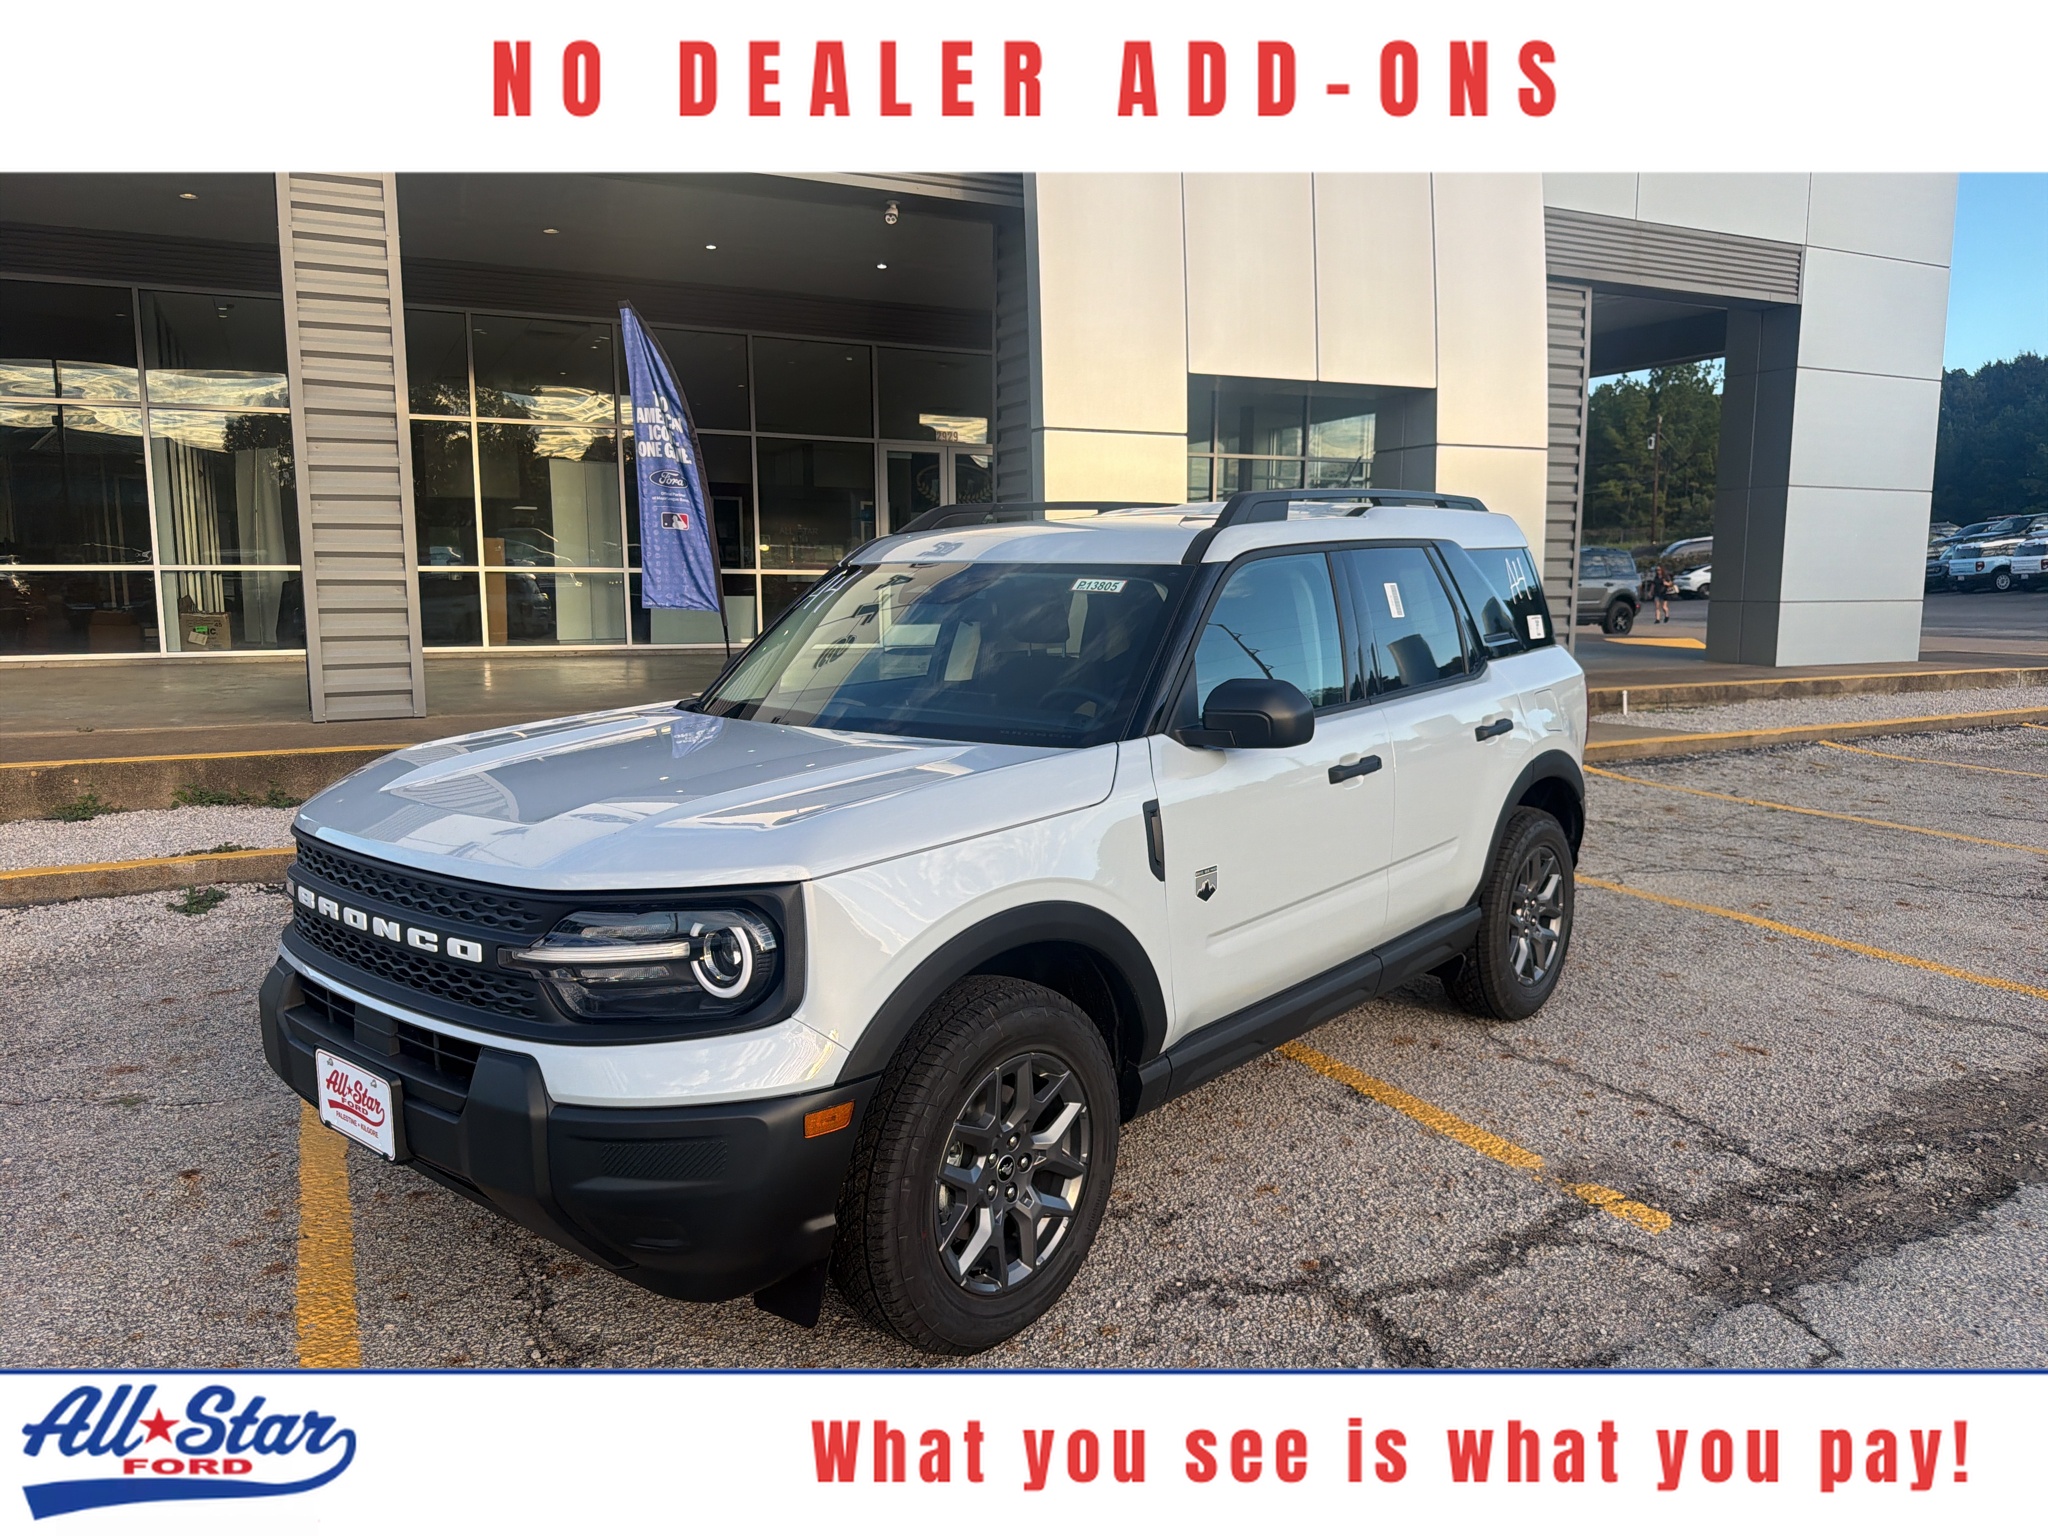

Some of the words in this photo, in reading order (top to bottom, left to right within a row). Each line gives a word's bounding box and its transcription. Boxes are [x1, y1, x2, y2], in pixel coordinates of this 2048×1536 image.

[936, 431, 959, 442] 2929
[638, 441, 663, 457] ONE
[298, 886, 482, 963] BRONCO
[326, 1069, 349, 1098] All
[352, 1080, 384, 1115] Star
[341, 1097, 369, 1116] FORD
[336, 1110, 358, 1127] PALESTINE
[360, 1124, 379, 1139] KILGORE
